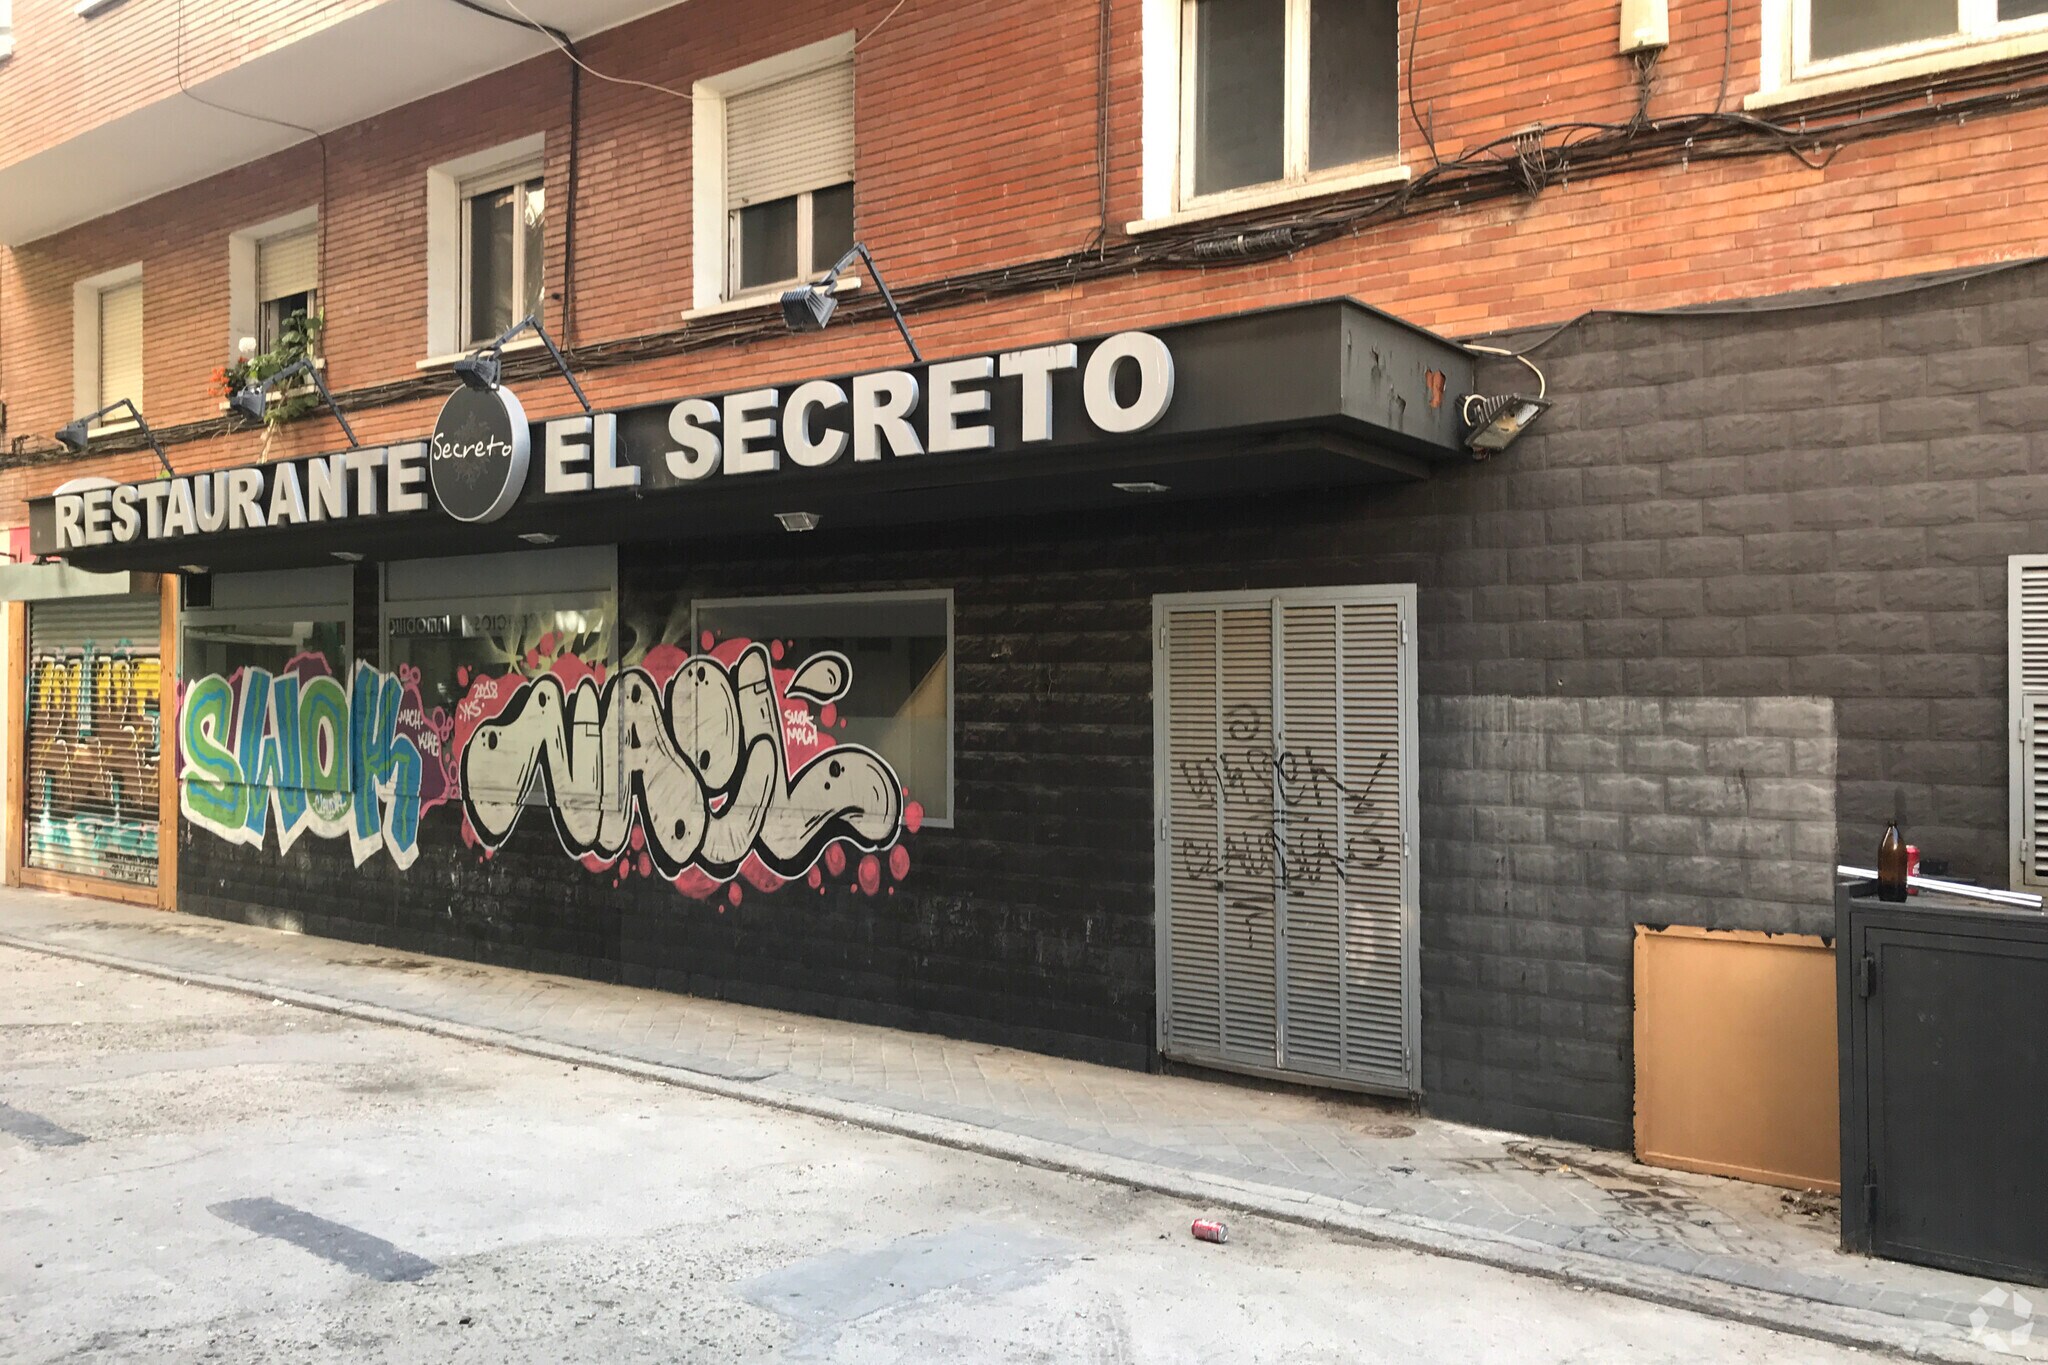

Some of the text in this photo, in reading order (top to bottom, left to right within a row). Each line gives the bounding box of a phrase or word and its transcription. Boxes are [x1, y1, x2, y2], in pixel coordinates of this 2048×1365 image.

[55, 330, 1176, 549] RESTAURANTE EL SECRETO
[433, 432, 512, 461] Secreto
